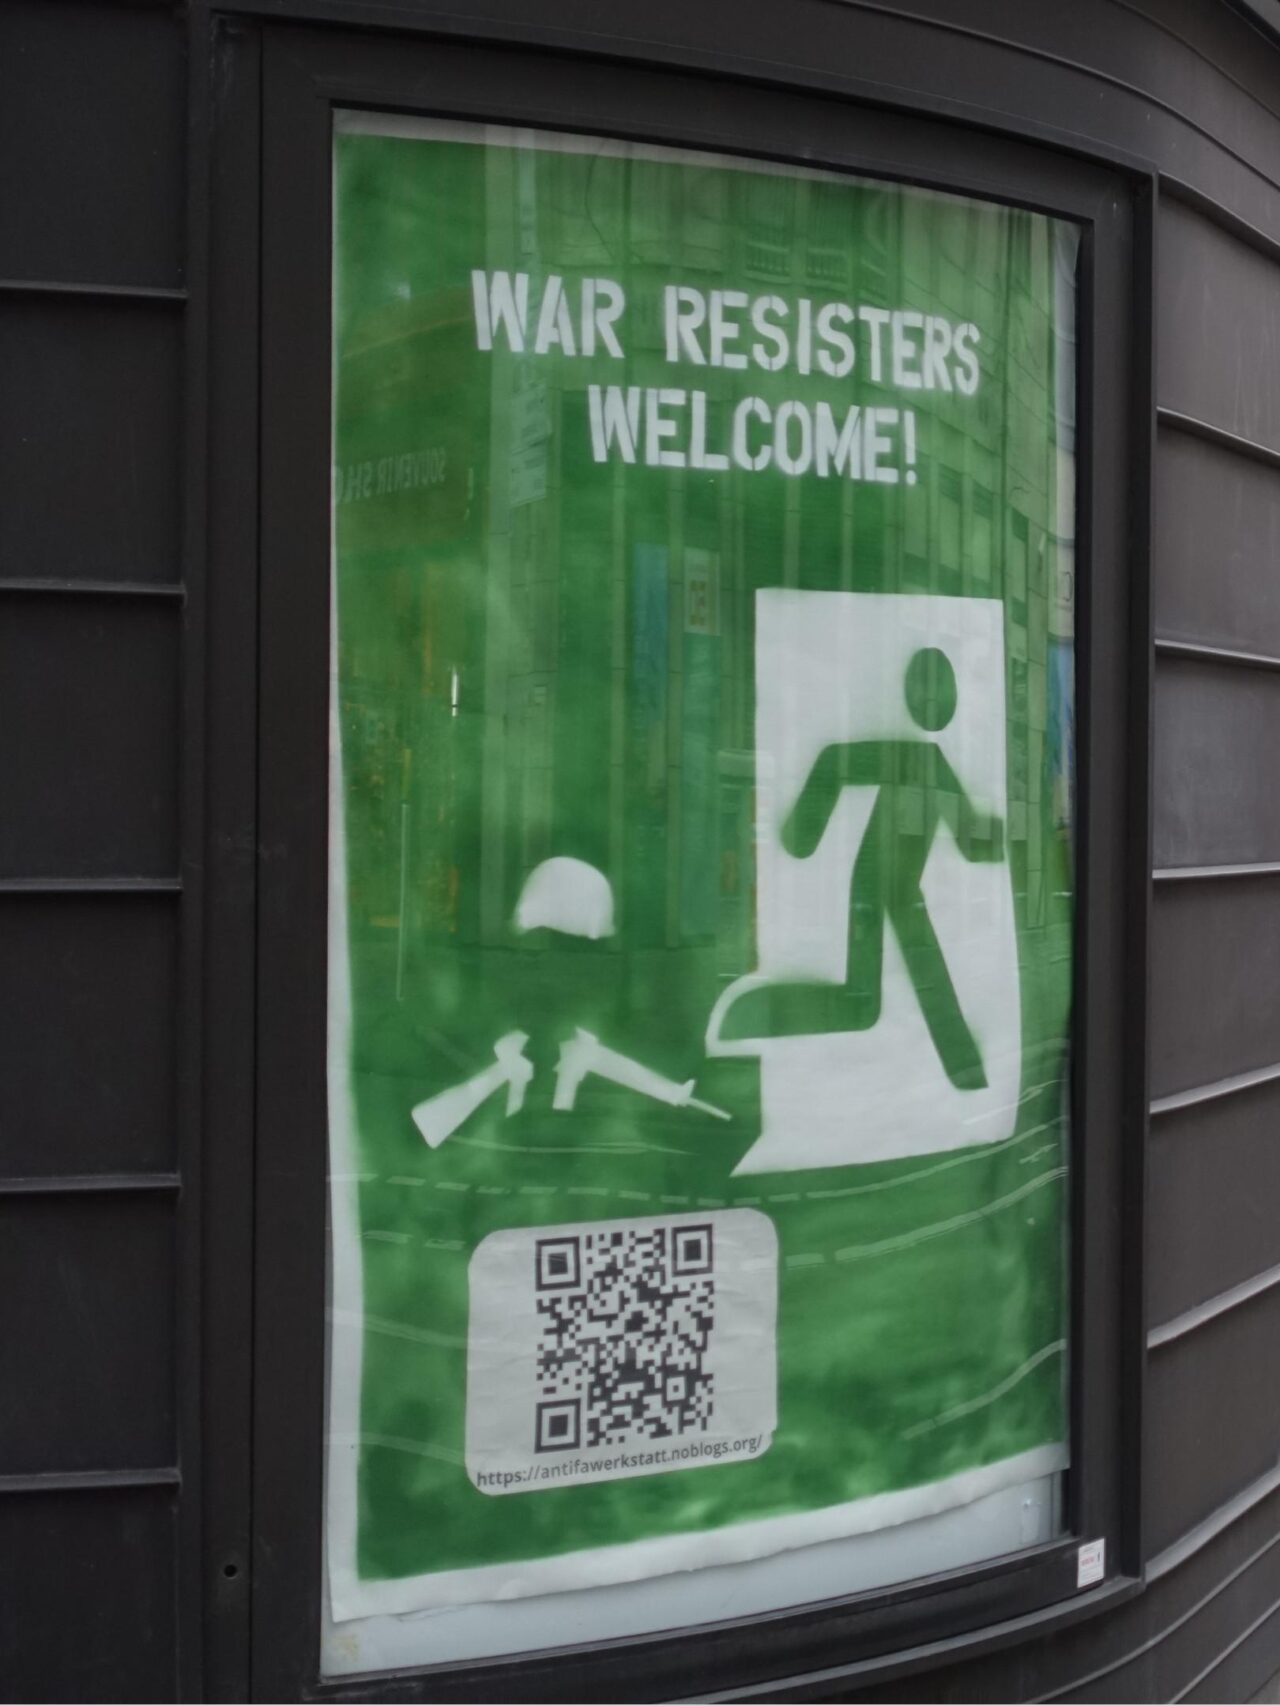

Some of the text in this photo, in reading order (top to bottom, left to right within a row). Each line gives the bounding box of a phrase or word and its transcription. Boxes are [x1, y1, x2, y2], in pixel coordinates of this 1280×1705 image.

[471, 270, 981, 396] WAR RESISTERS
[588, 384, 917, 485] WELCOME!
[477, 1435, 763, 1488] https://antifawerkstatt.noblogs.org/
